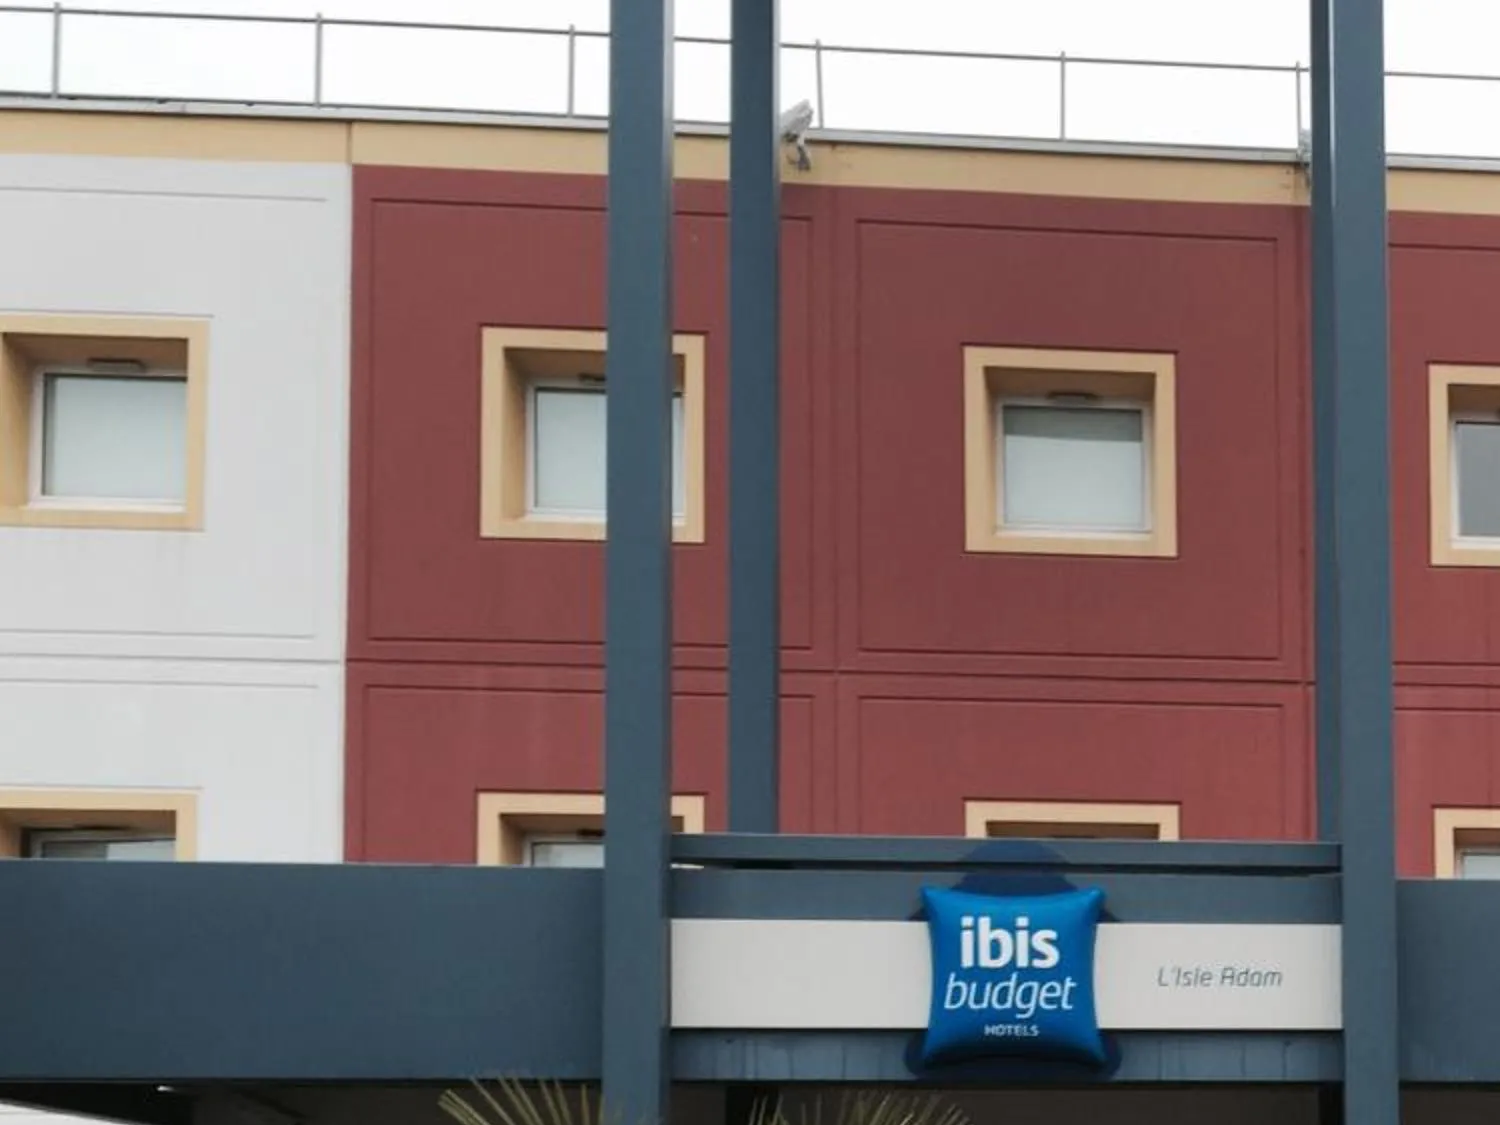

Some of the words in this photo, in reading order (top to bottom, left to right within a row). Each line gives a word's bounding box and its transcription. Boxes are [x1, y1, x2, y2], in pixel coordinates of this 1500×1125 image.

[961, 916, 1060, 968] ibis
[1158, 966, 1213, 987] L'Isle
[1220, 966, 1282, 987] Adam
[944, 971, 1077, 1019] budget
[984, 1024, 1040, 1037] HOTELS
